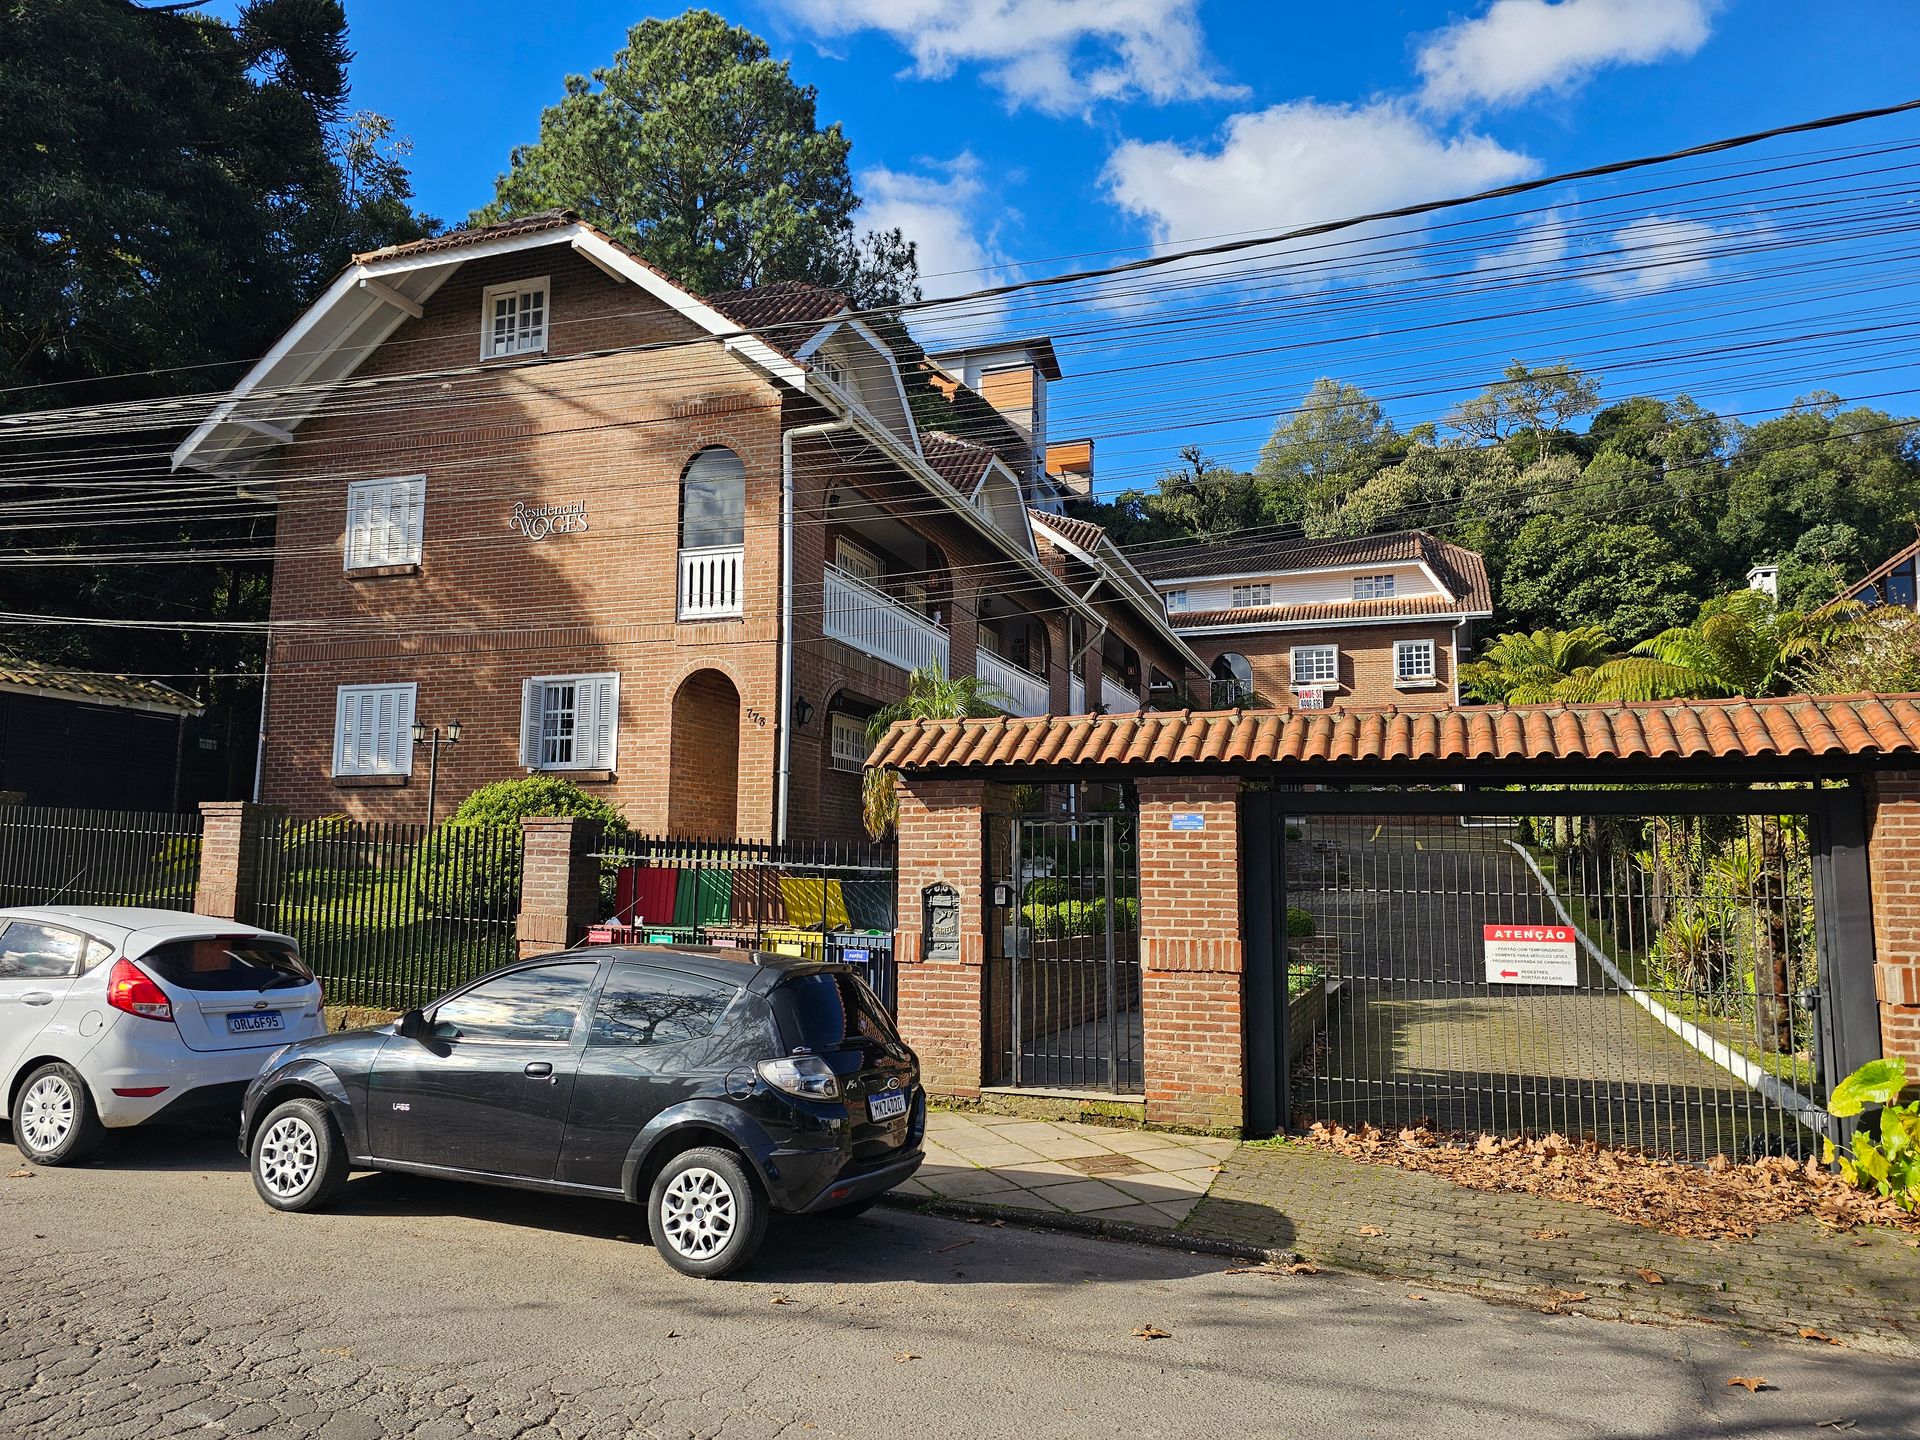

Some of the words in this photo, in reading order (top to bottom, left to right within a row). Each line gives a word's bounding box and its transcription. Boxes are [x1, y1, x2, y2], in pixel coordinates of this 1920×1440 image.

[511, 500, 585, 517] Residencial
[509, 513, 589, 540] VOGES
[746, 708, 766, 727] 773
[1494, 929, 1566, 940] ATENÇÃO
[234, 1016, 279, 1030] ORL6F95
